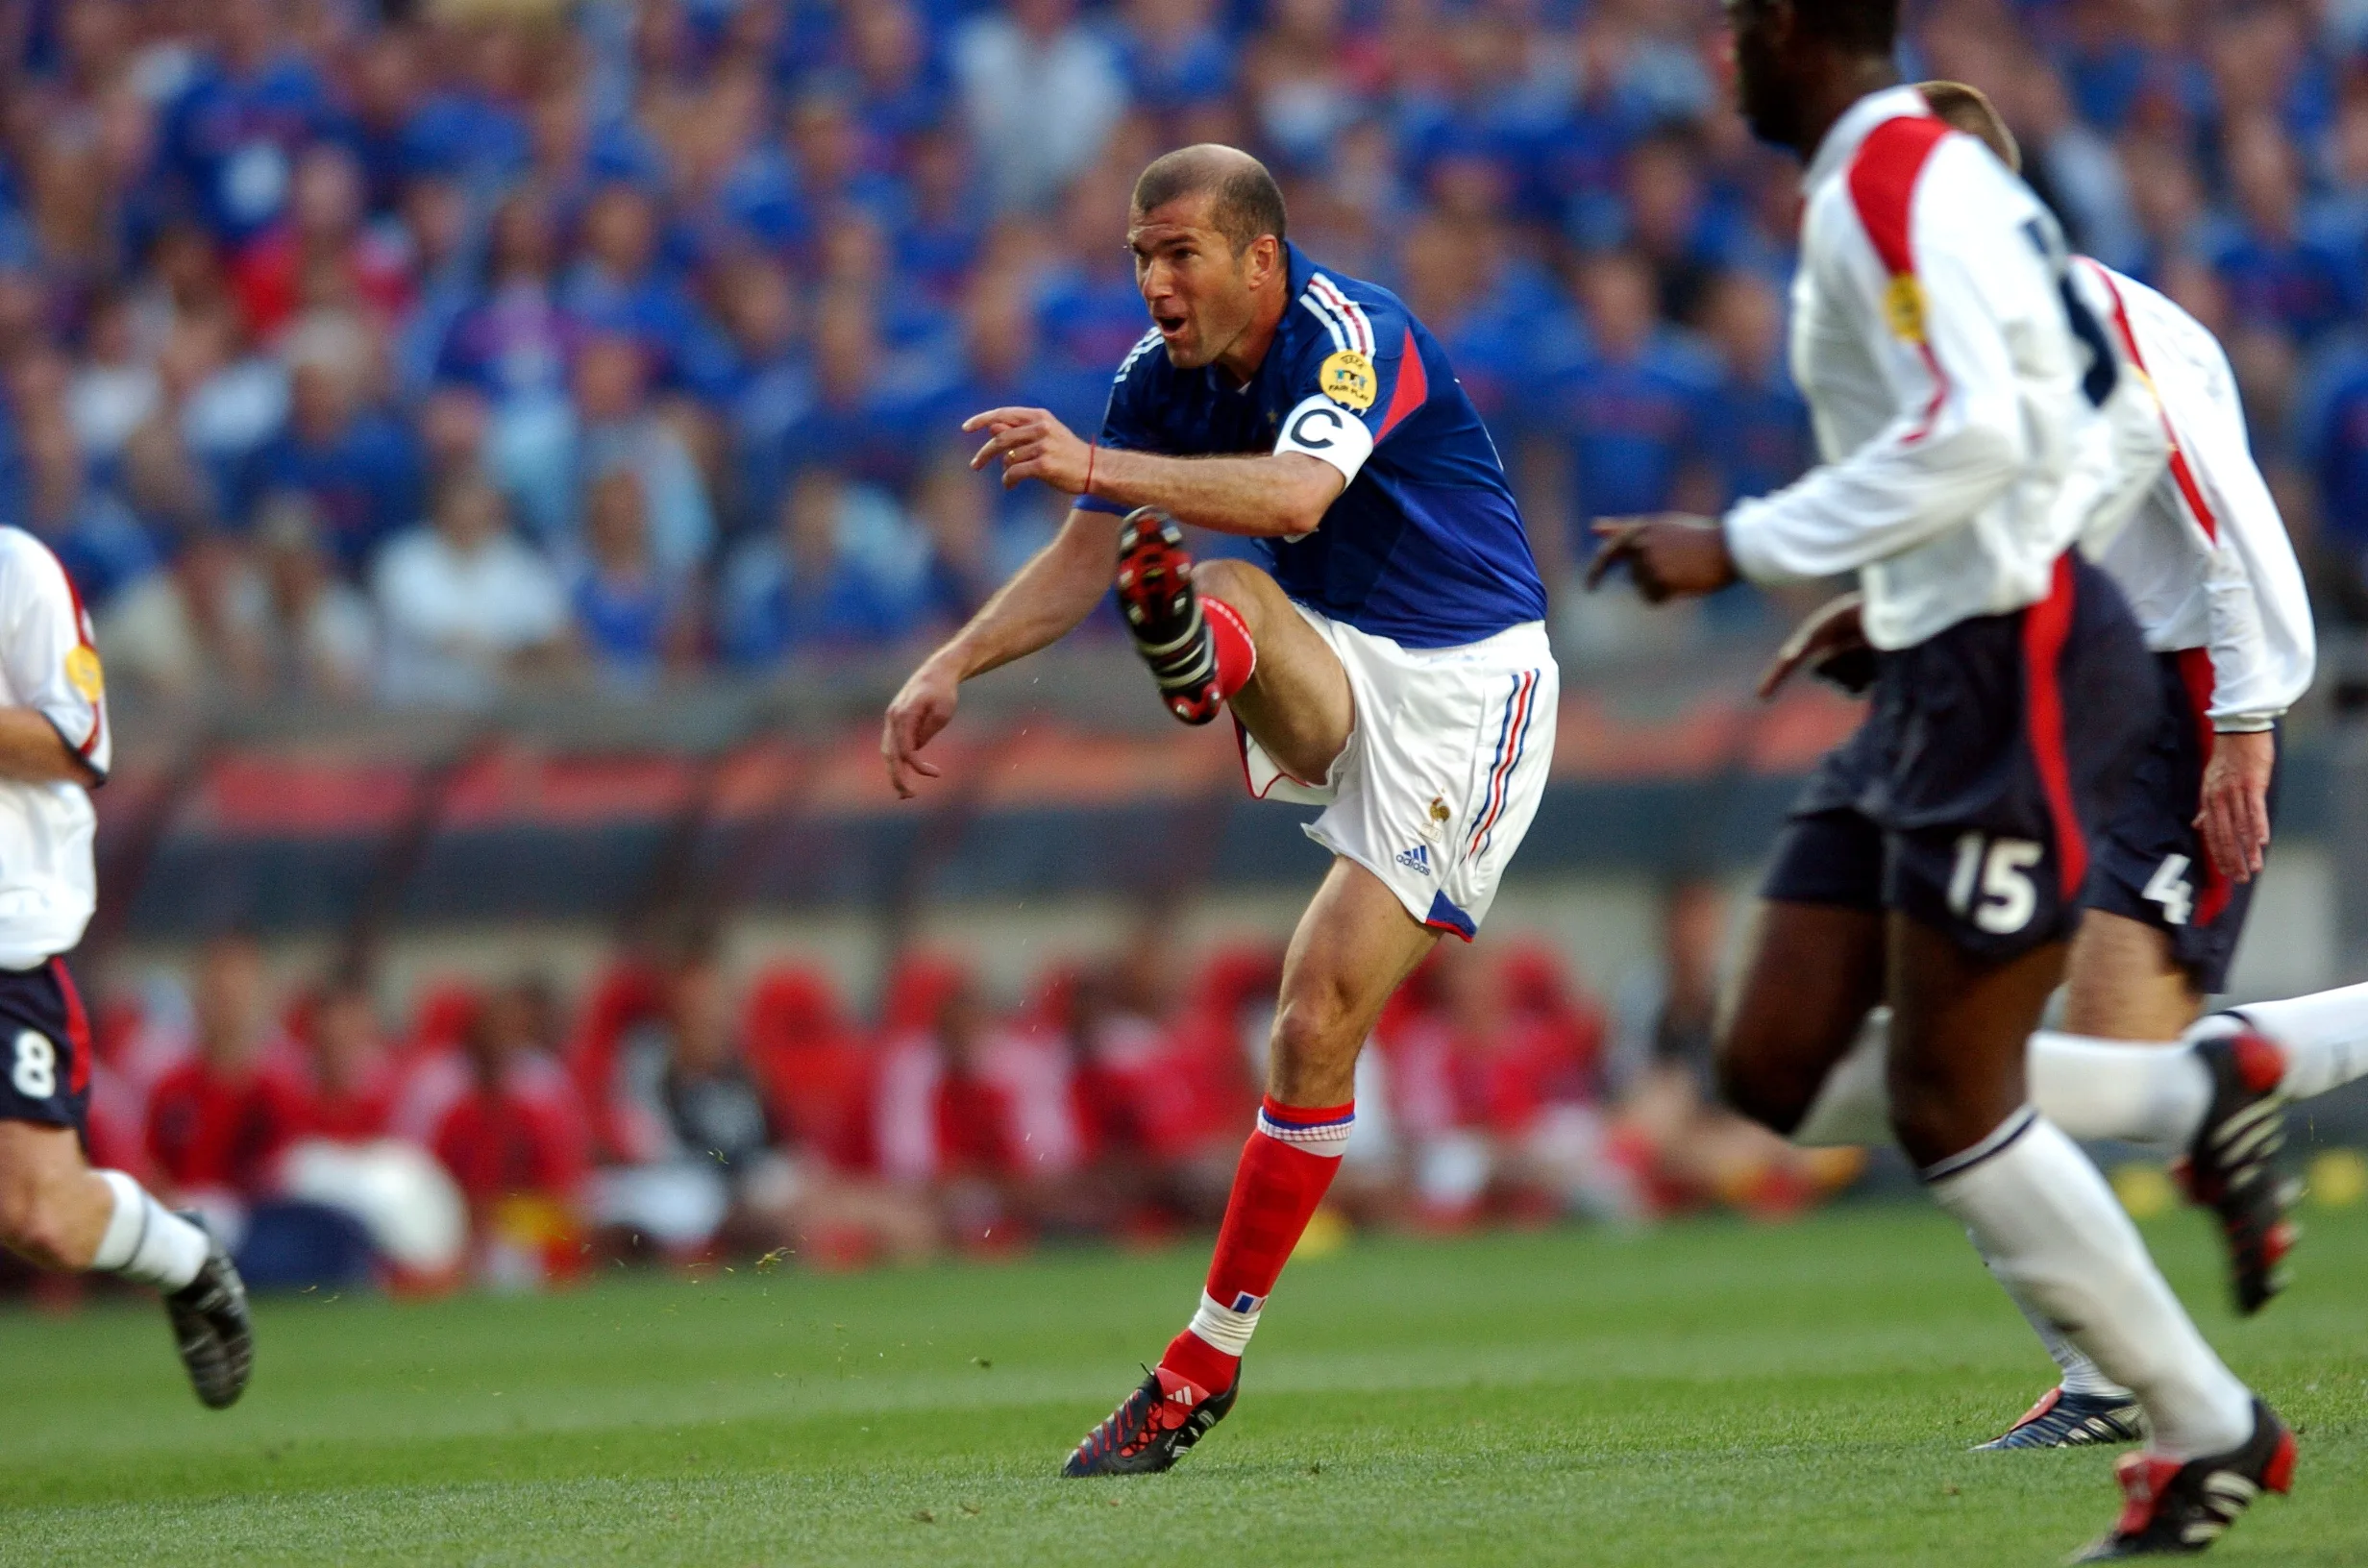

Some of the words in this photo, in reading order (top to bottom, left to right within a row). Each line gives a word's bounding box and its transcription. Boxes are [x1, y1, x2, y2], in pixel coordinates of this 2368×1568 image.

[1291, 408, 1344, 449] C
[1395, 854, 1431, 876] adidas
[1947, 832, 2043, 934] 15
[2141, 853, 2193, 924] 4
[13, 1029, 56, 1099] 8
